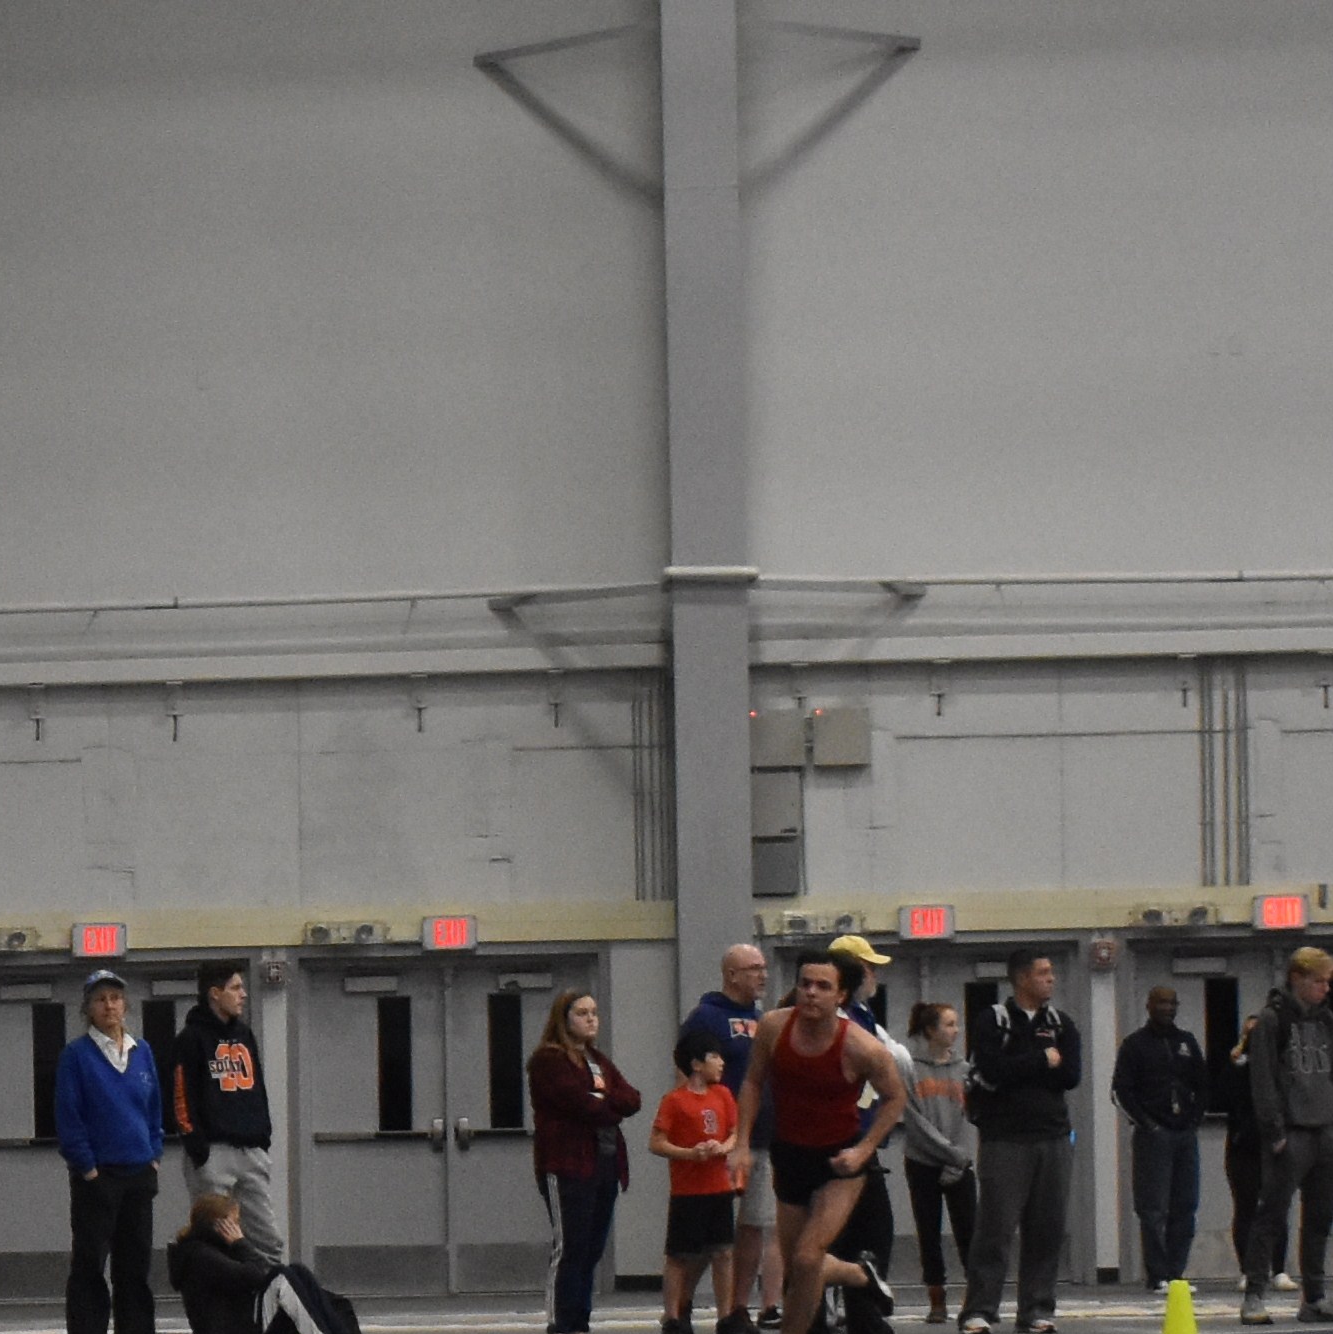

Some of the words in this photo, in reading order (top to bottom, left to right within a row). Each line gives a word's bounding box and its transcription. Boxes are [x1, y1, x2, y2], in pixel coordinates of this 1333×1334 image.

[910, 908, 945, 936] EXIT
[1263, 897, 1302, 926] EXIT
[83, 926, 118, 954] EXIT
[433, 919, 468, 946] EXIT
